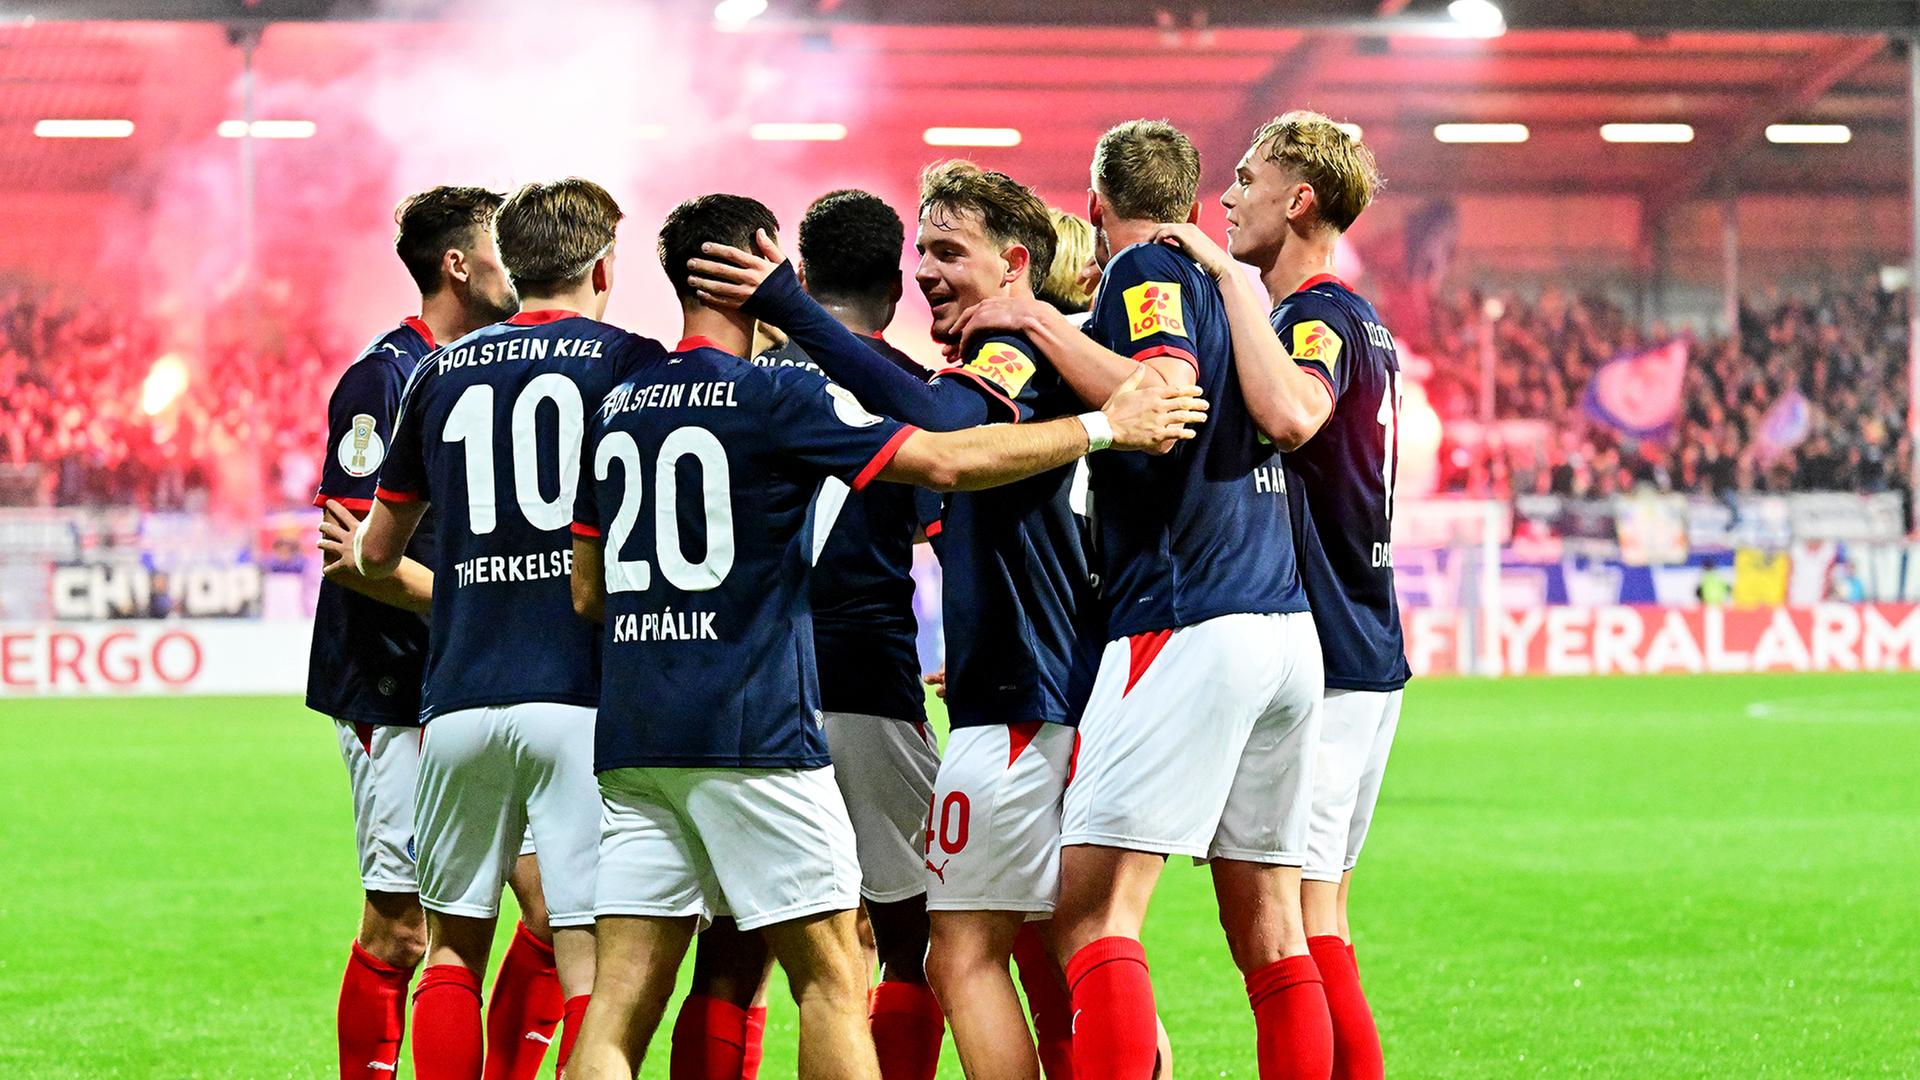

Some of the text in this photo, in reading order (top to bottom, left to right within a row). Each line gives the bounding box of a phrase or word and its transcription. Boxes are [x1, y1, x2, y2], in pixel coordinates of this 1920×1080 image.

[1133, 313, 1181, 335] LOTTO
[438, 338, 604, 375] HOLSTEIN KIEL
[602, 381, 738, 418] HOLSTEIN KIEL
[442, 372, 585, 536] 10
[594, 425, 735, 595] 20
[612, 606, 718, 643] KAPRÁLIK
[1411, 604, 1920, 675] FLYERALARM
[0, 630, 203, 686] ERGO
